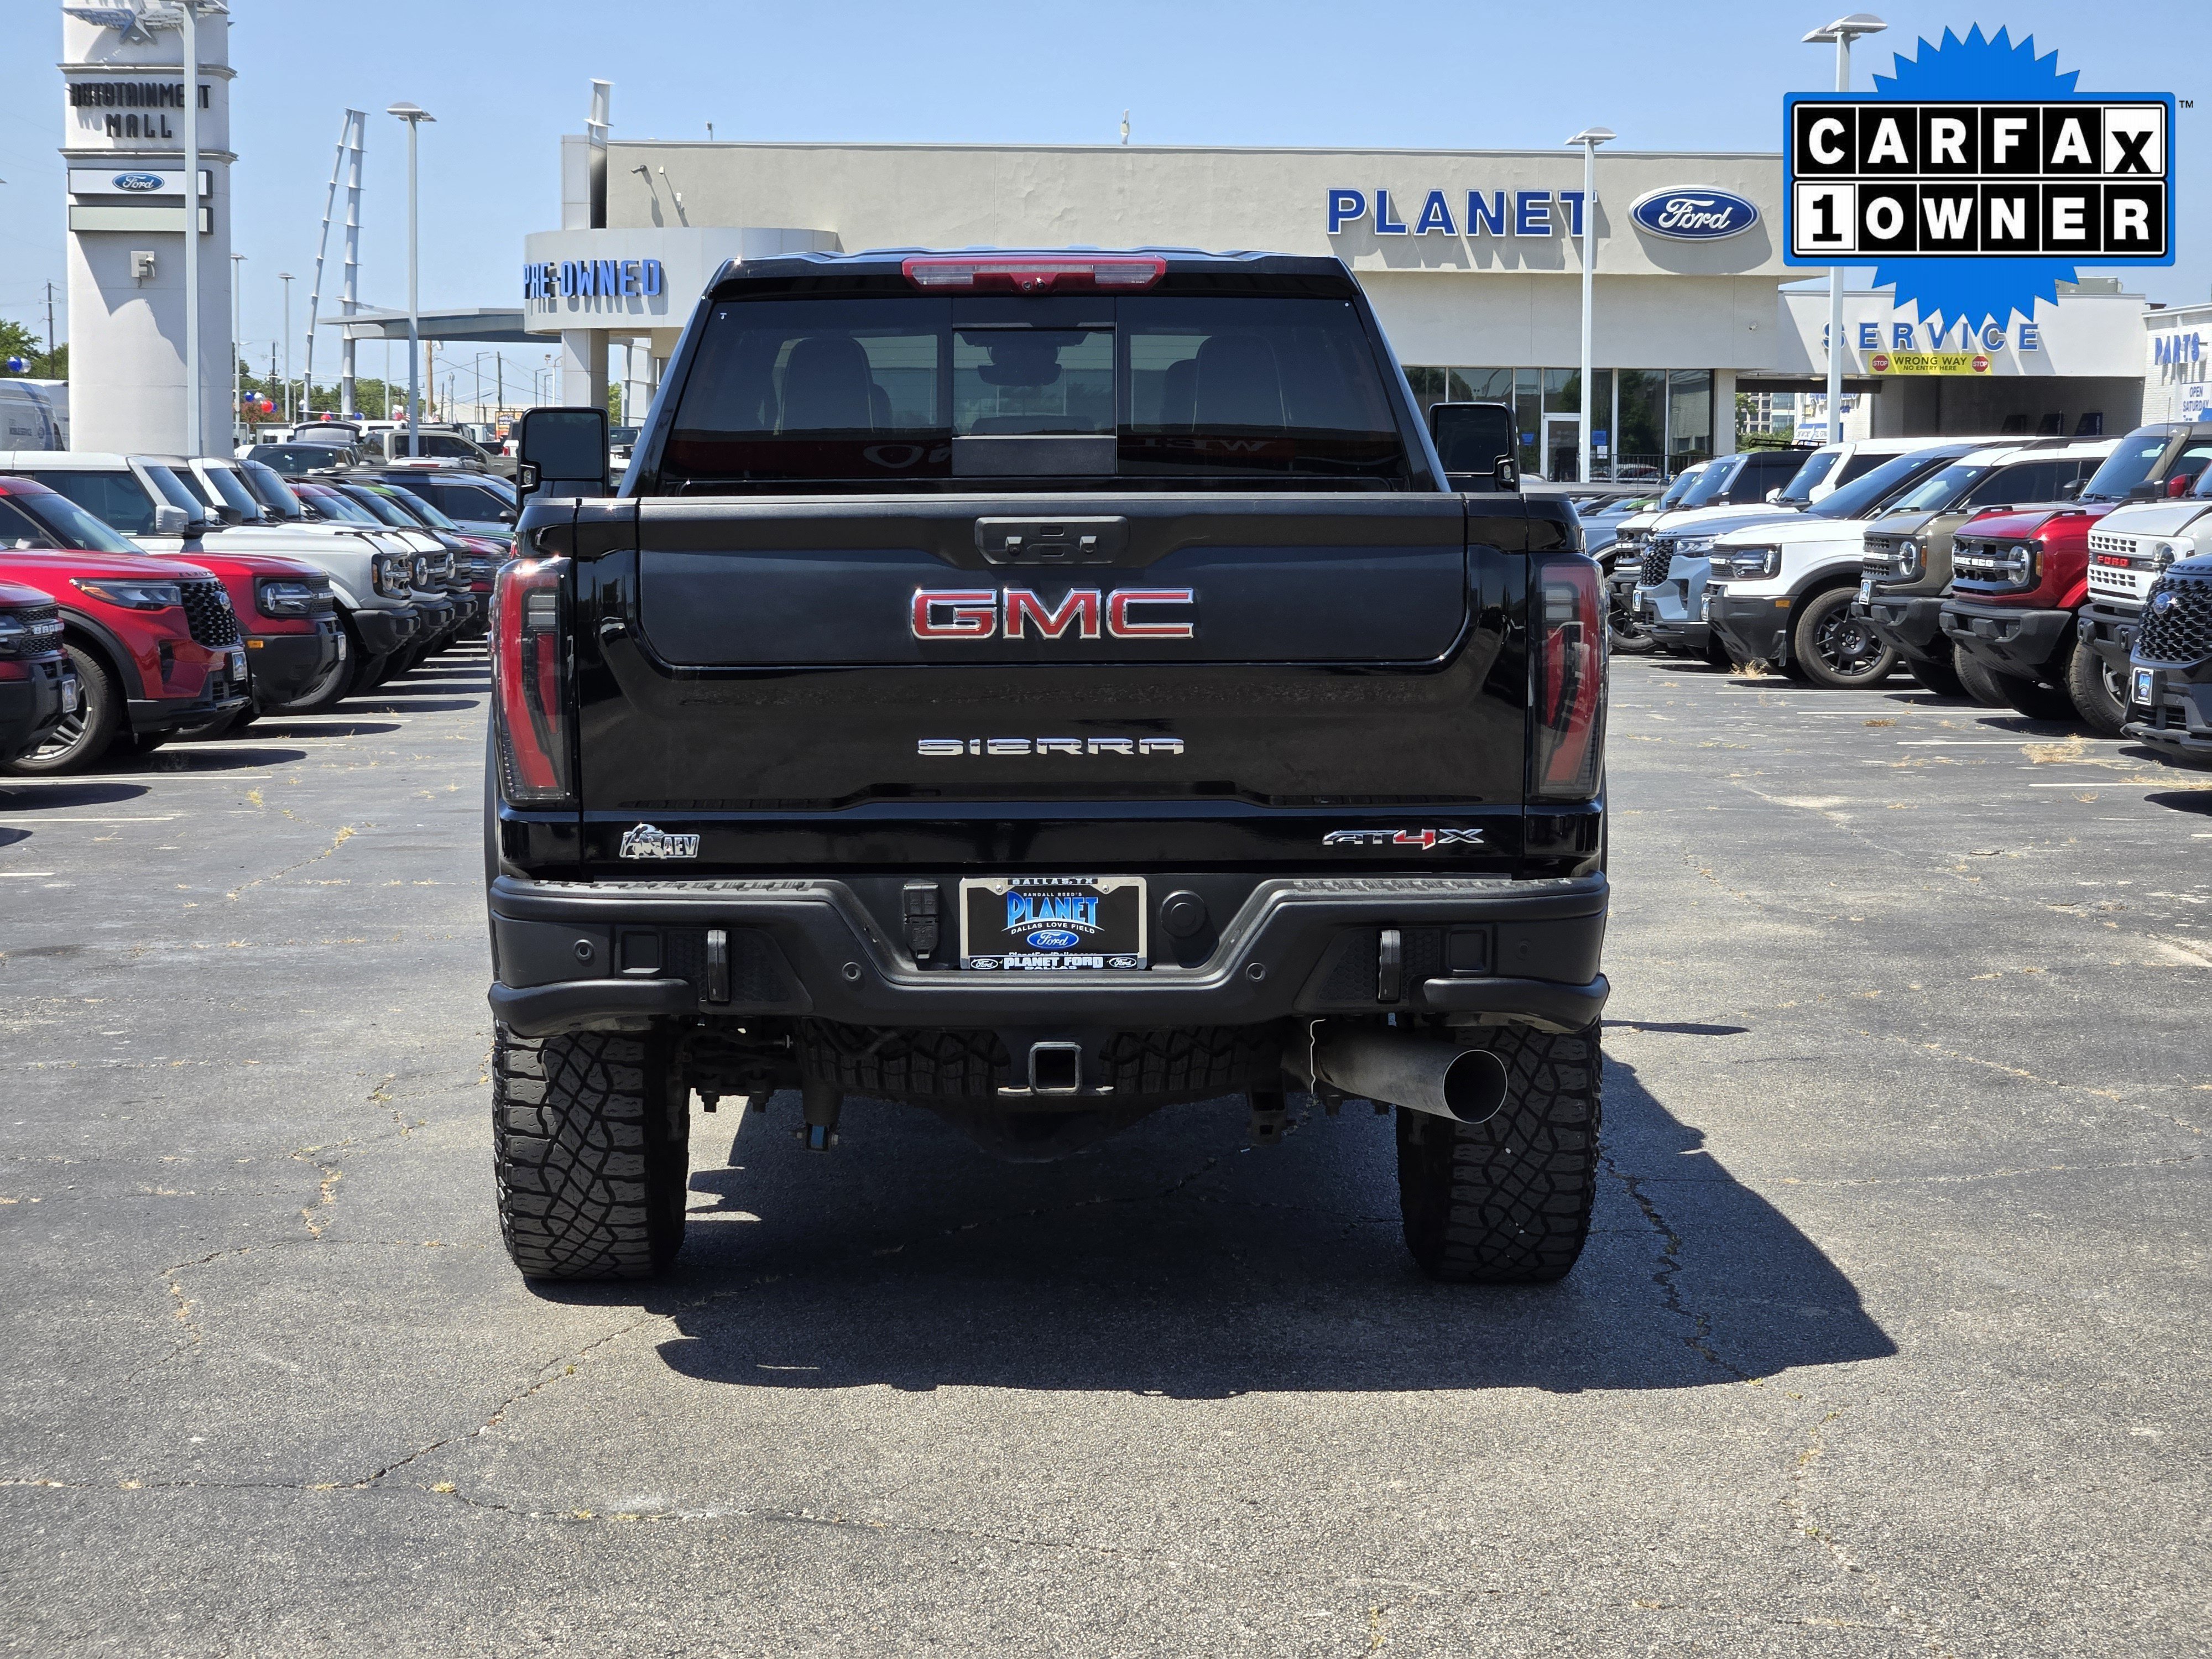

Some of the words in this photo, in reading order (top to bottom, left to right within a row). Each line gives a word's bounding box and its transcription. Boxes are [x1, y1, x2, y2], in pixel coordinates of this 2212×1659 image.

[70, 82, 211, 108] AUTOTAINMET
[106, 113, 172, 138] MALL
[1327, 188, 1598, 237] PLANET
[523, 259, 663, 299] PRE-OWNED
[2154, 332, 2200, 365] PARTS
[1893, 357, 1938, 366] WRONG
[1942, 357, 1967, 366] WAY
[2189, 385, 2203, 398] OPEN
[2183, 399, 2209, 412] SATURDAY
[2098, 556, 2129, 567] FORD
[911, 588, 1194, 640] GMC
[918, 738, 1184, 755] SIERRA
[664, 837, 697, 855] AEV
[1322, 829, 1485, 850] AT4X
[1008, 891, 1098, 928] PLANET
[1011, 922, 1043, 935] DALLAS
[1071, 924, 1095, 934] FIELD
[1004, 957, 1060, 969] PLANET
[1064, 957, 1104, 968] FORD
